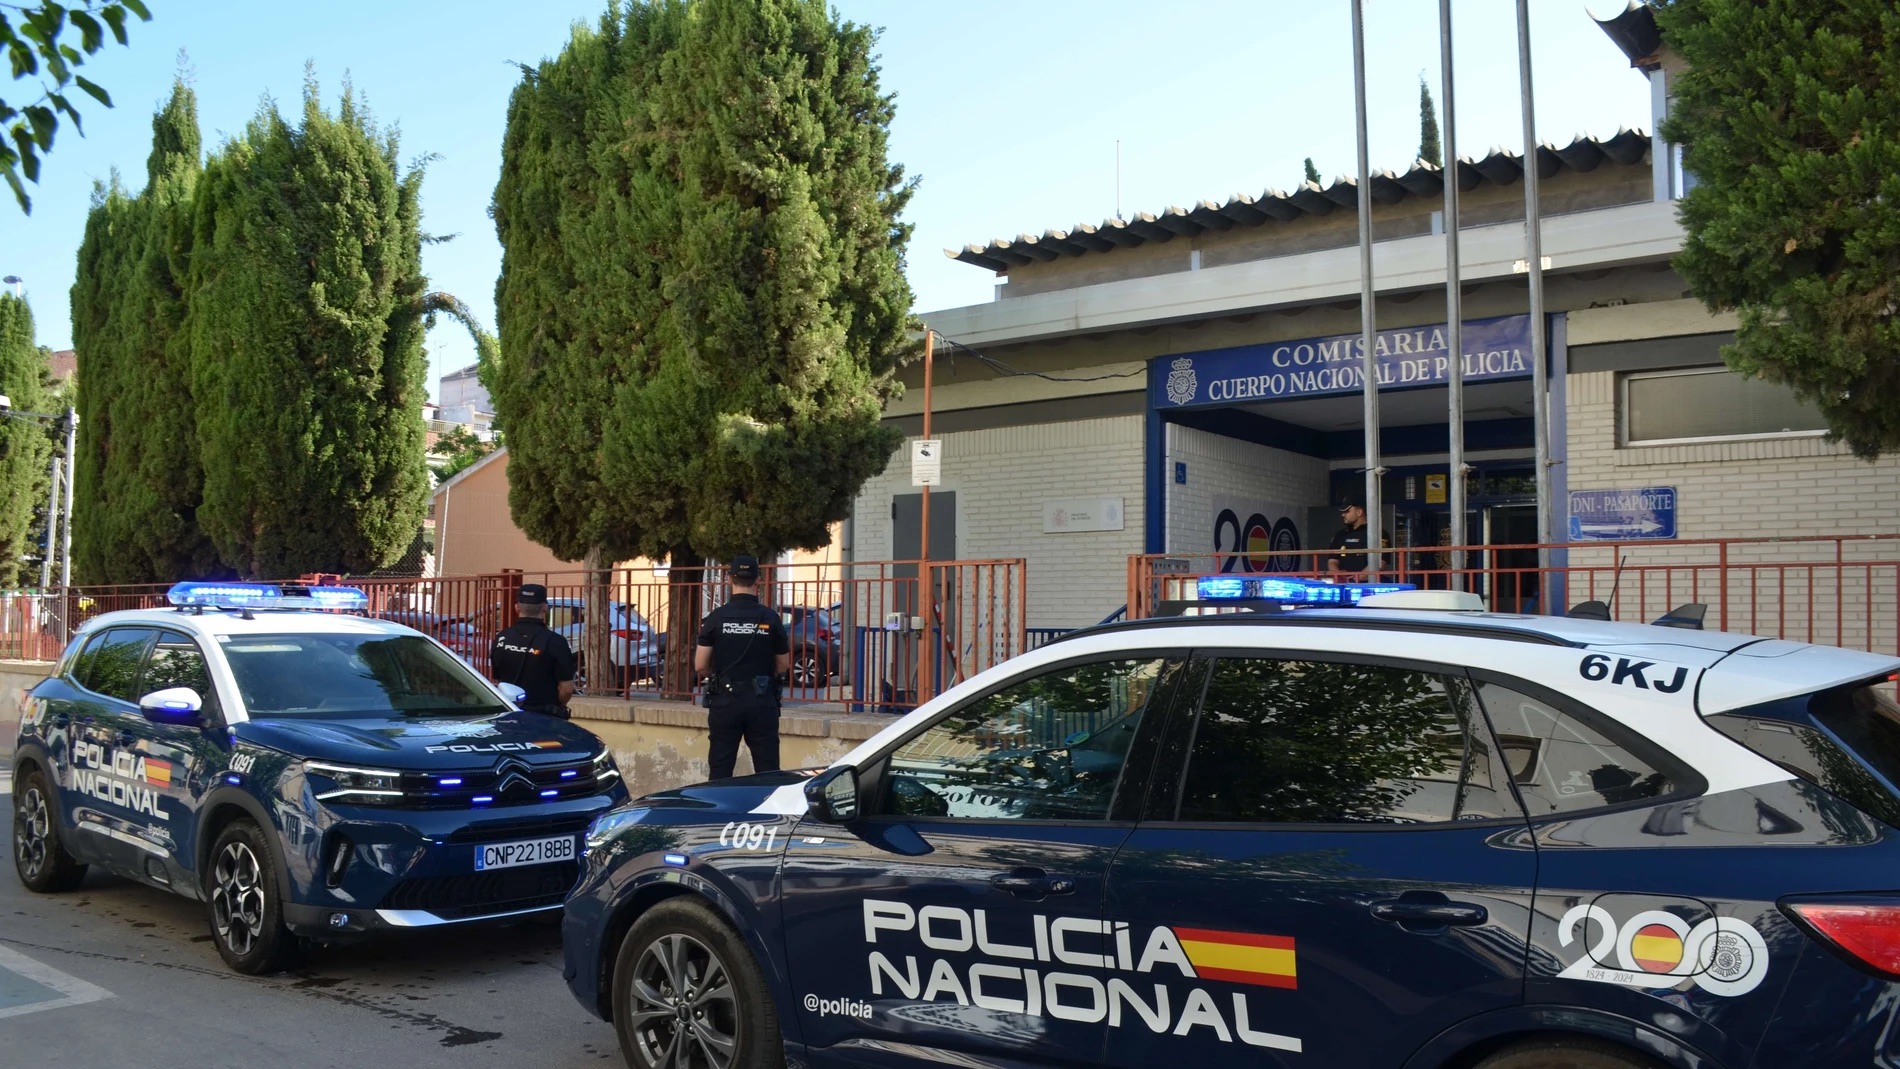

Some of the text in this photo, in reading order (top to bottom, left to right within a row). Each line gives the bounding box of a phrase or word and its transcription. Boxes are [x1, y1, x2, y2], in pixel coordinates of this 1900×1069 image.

[1272, 329, 1448, 368] COMISARIA
[1208, 373, 1286, 400] CUERPO
[1400, 359, 1430, 382] DE
[1434, 349, 1526, 379] PLICIA
[1573, 497, 1595, 513] DNI
[1604, 494, 1672, 512] PASAPORTE
[504, 644, 535, 653] POLICA
[1579, 654, 1689, 694] 6KJ
[234, 753, 256, 773] 091
[73, 768, 169, 820] NACIONAL
[148, 822, 170, 839] @policia
[732, 824, 778, 852] 091
[485, 838, 572, 866] CNP2218BB
[1555, 904, 1769, 997] 200
[1585, 969, 1605, 980] 1824
[1613, 972, 1634, 983] 2024
[803, 993, 873, 1019] @policia
[868, 951, 1303, 1053] NACIONAL
